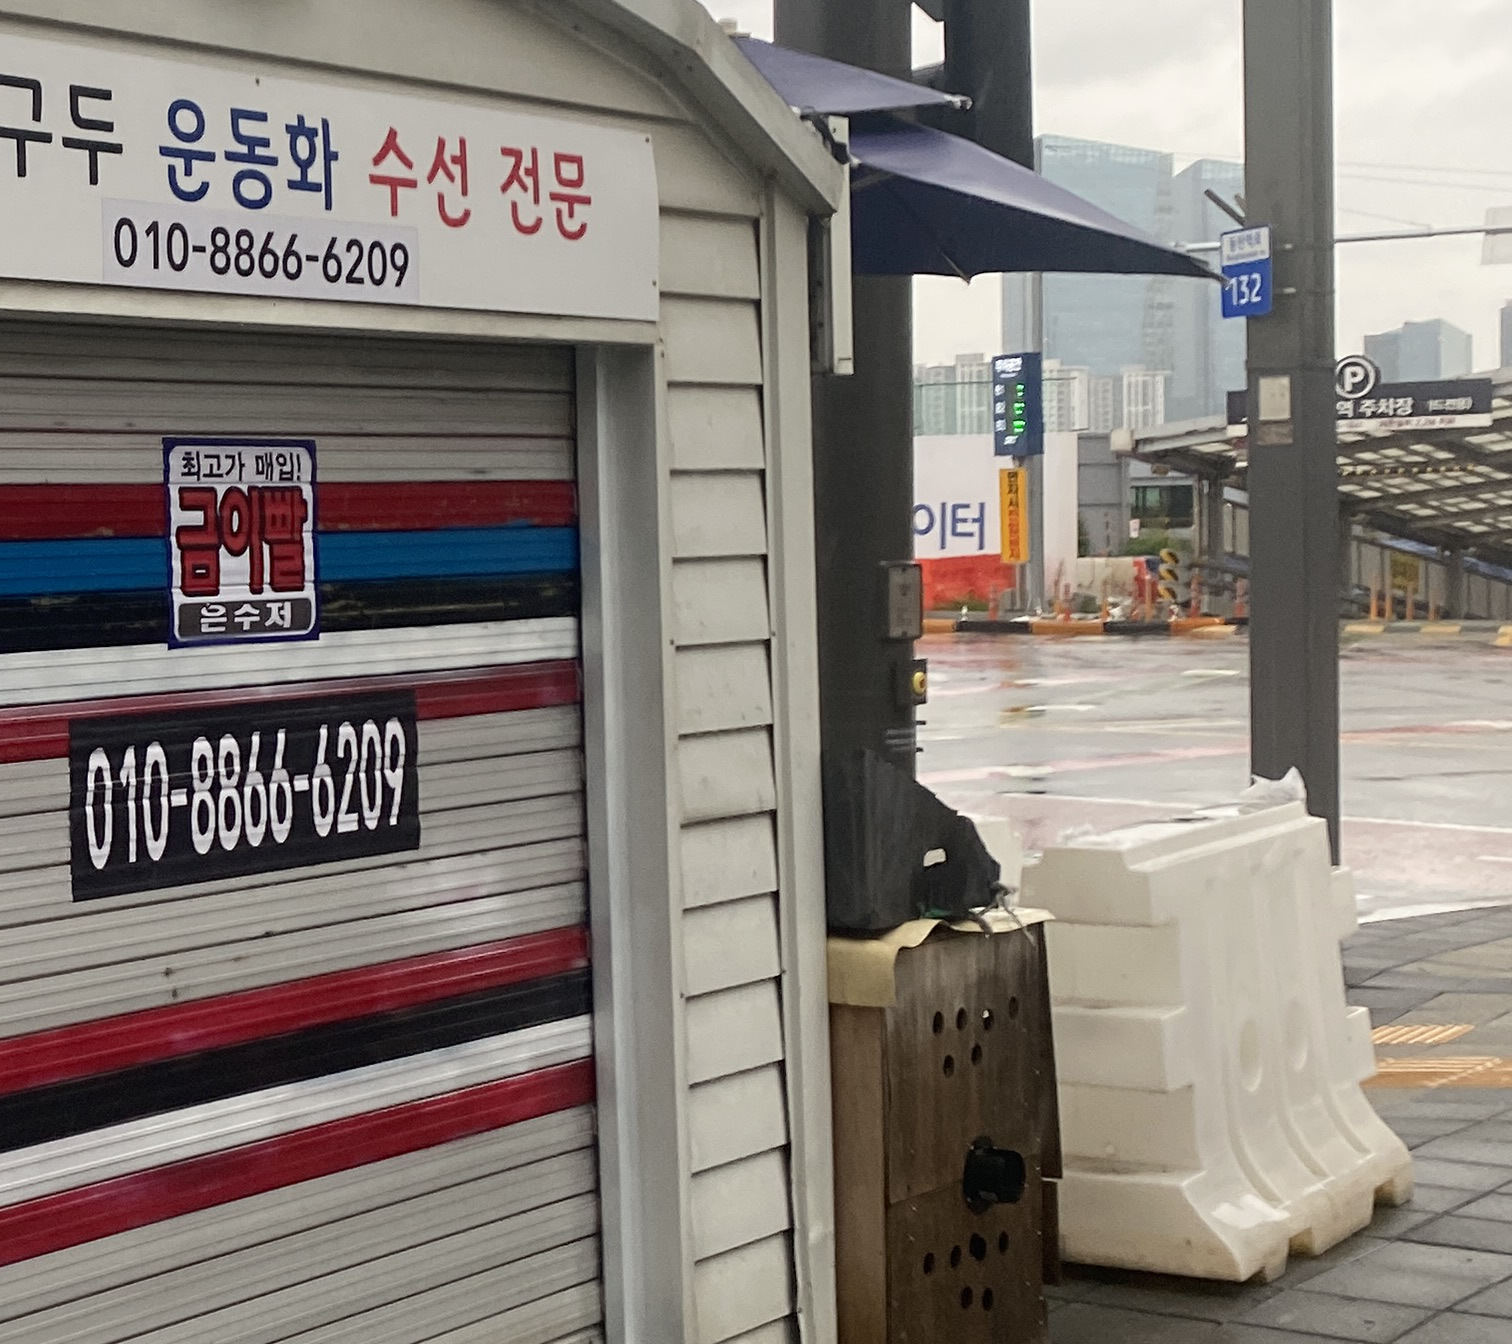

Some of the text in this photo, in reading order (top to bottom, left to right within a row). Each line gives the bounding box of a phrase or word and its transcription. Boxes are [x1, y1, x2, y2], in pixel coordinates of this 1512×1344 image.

[158, 98, 339, 212] 운동화
[368, 126, 472, 229] 수선
[499, 145, 593, 242] 전문
[113, 216, 410, 288] 010-8866-6209
[1225, 272, 1262, 306] 132
[1358, 396, 1414, 418] 주차장
[180, 451, 302, 482] 최고가 매입!
[175, 485, 309, 598] 금이빨
[199, 601, 293, 634] 은수저
[85, 715, 407, 870] 010-8866-6209
